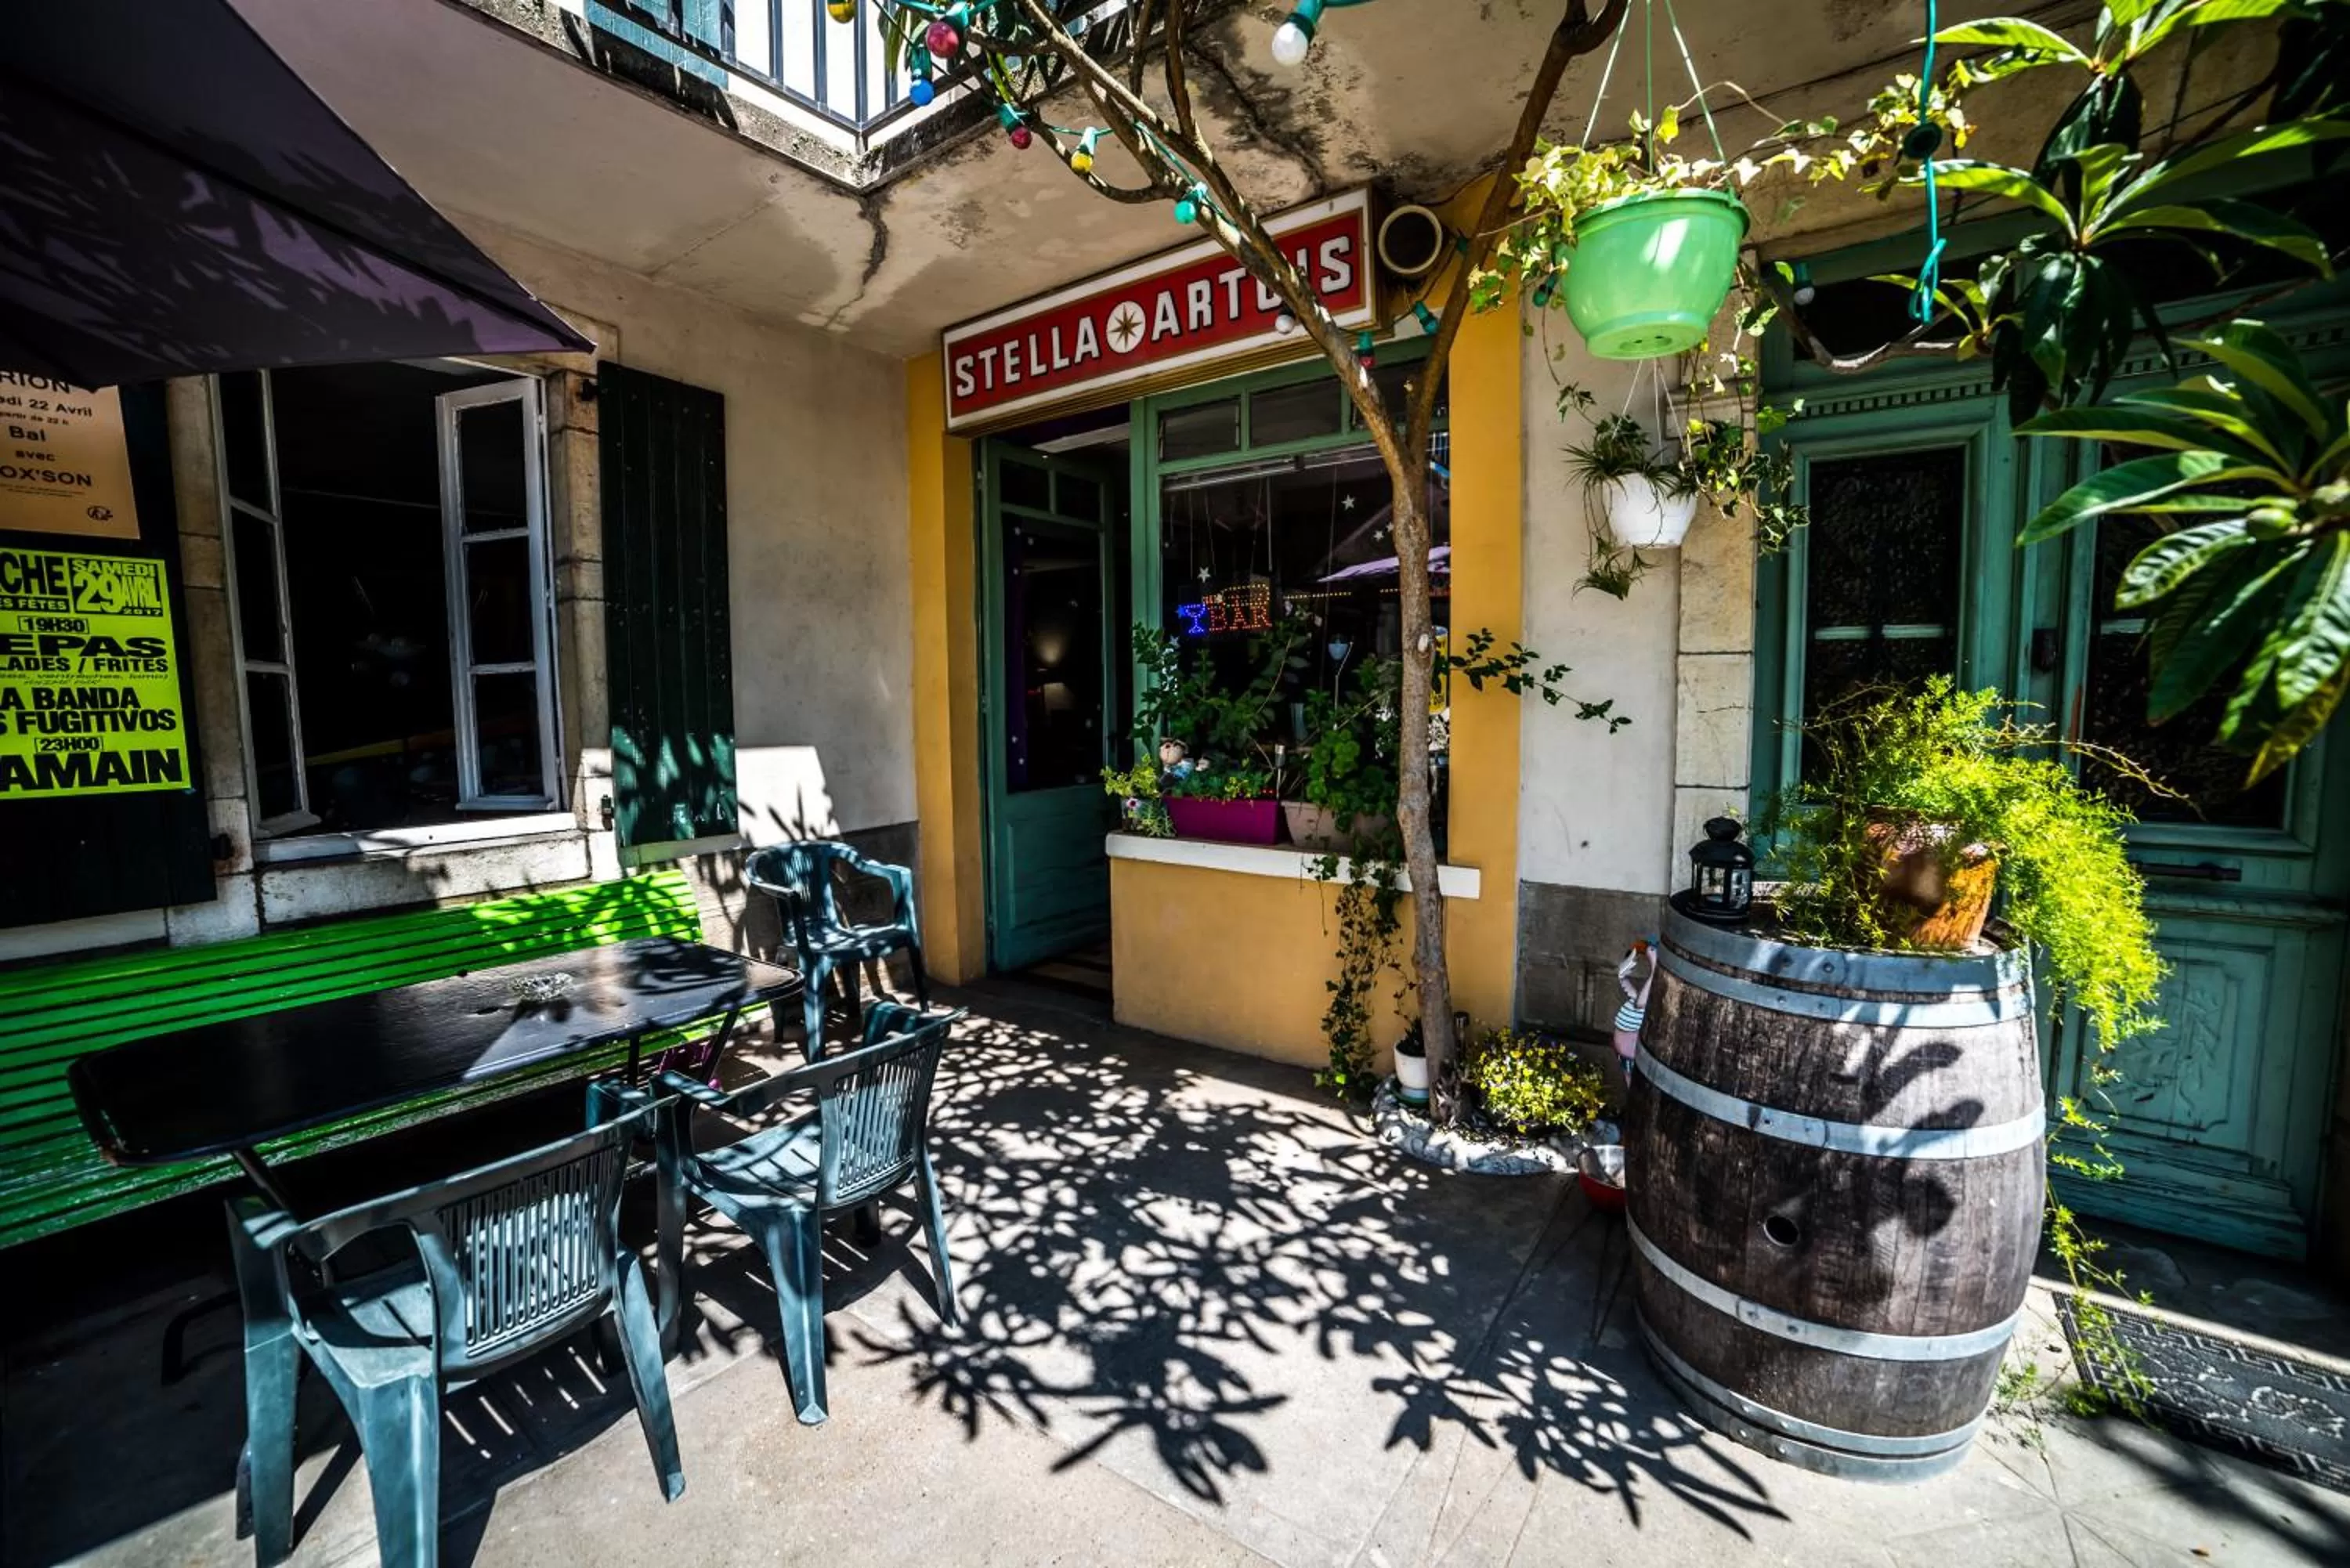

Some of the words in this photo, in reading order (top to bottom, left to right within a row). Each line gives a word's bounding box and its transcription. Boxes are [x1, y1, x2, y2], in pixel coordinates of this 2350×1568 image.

[954, 316, 1100, 398] STELLA
[29, 398, 49, 411] 22
[56, 403, 92, 417] Avril
[9, 425, 46, 443] Bal
[15, 450, 56, 462] avec
[71, 559, 156, 577] SAMEDI
[73, 571, 124, 613] 29
[0, 598, 13, 609] S
[23, 616, 86, 634] 19H30
[1207, 604, 1274, 631] BAR
[93, 658, 168, 673] FRITES
[31, 687, 141, 710] BANDA
[16, 709, 177, 735] FUGITIVOS
[39, 738, 100, 752] 23H00
